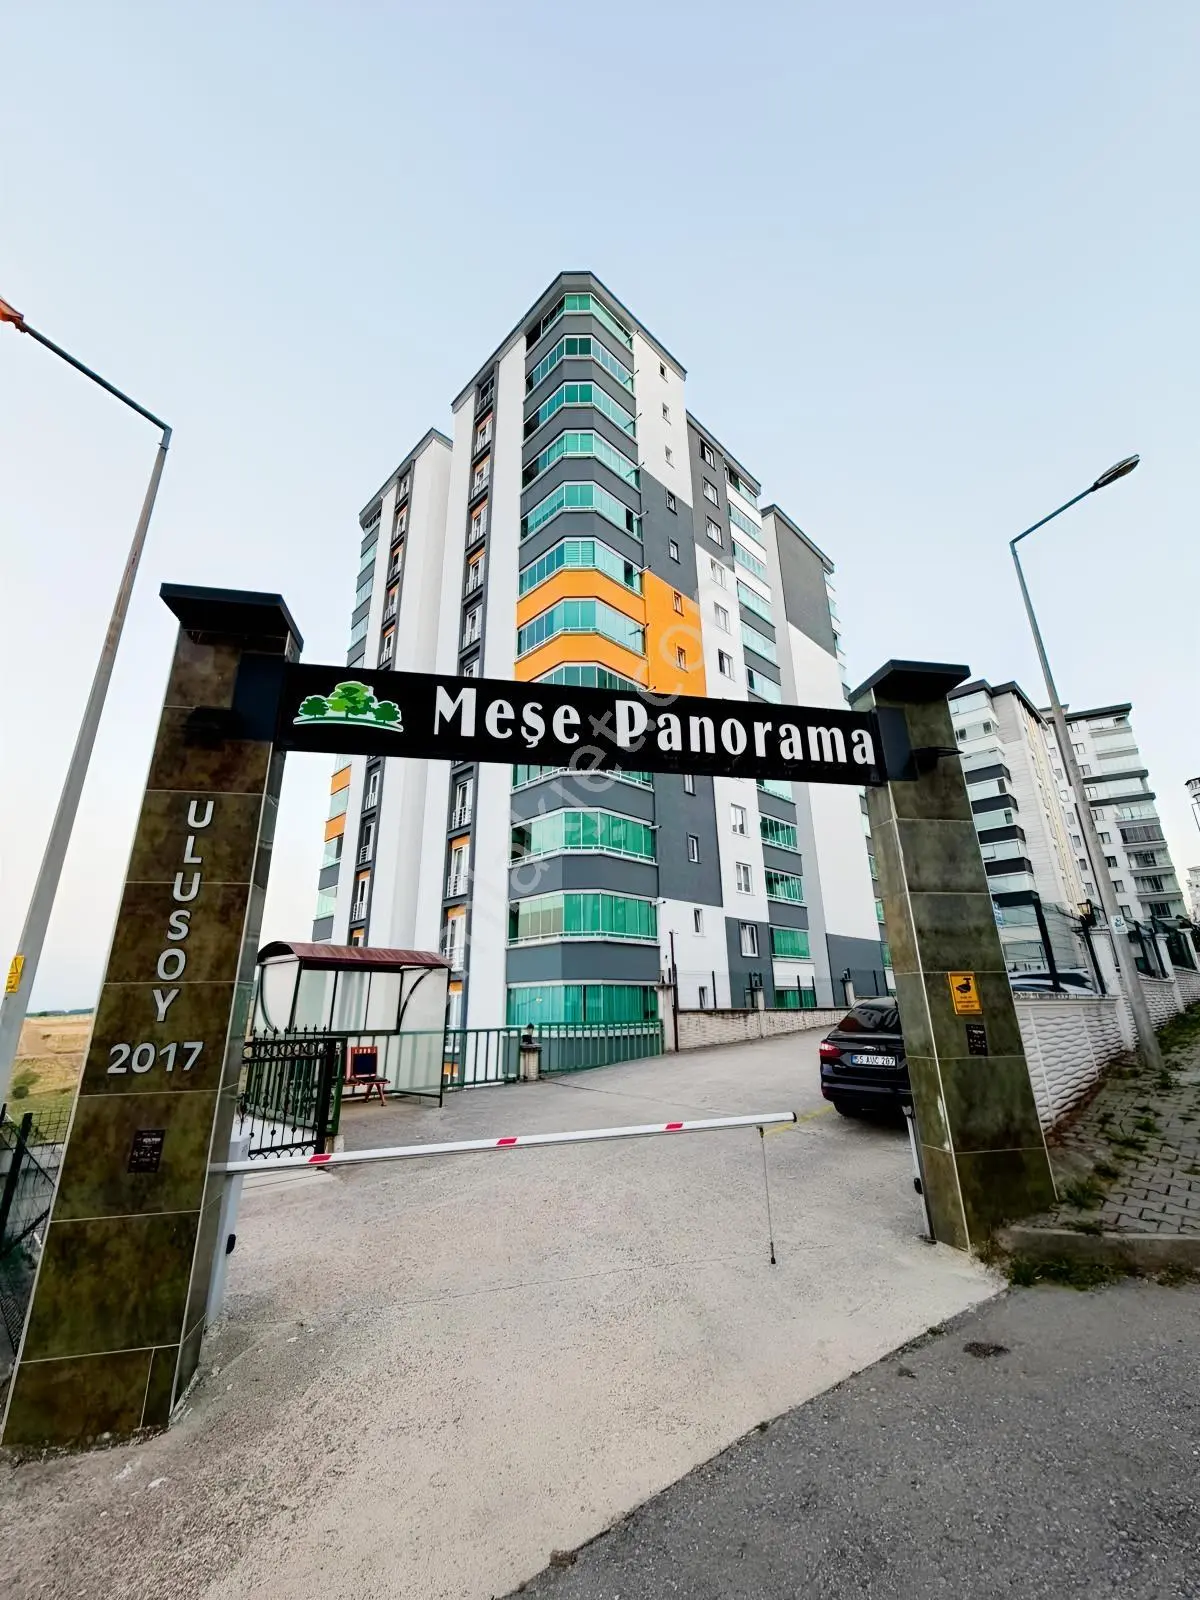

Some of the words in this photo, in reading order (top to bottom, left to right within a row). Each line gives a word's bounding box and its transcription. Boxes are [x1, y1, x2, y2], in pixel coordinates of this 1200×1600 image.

[434, 685, 582, 748] Meşe
[615, 700, 876, 765] Panorama
[152, 800, 214, 1022] ULUSOY
[107, 1041, 204, 1075] 2017
